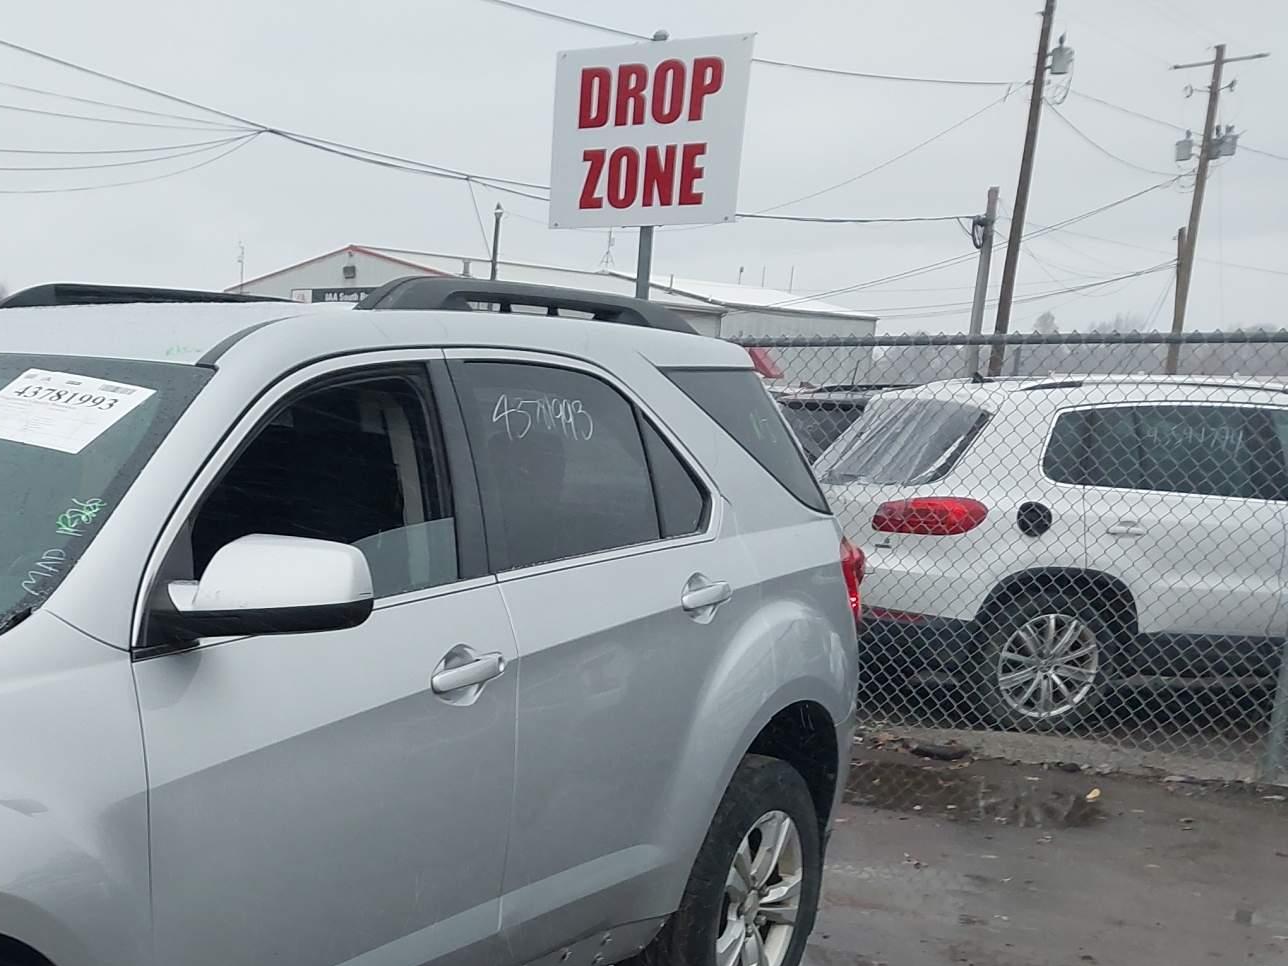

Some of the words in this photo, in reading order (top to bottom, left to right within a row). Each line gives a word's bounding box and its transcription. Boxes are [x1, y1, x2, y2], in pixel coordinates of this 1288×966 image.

[578, 56, 725, 129] DROP
[579, 142, 707, 210] ZONE
[13, 384, 120, 411] 43781993
[21, 548, 66, 596] MAD
